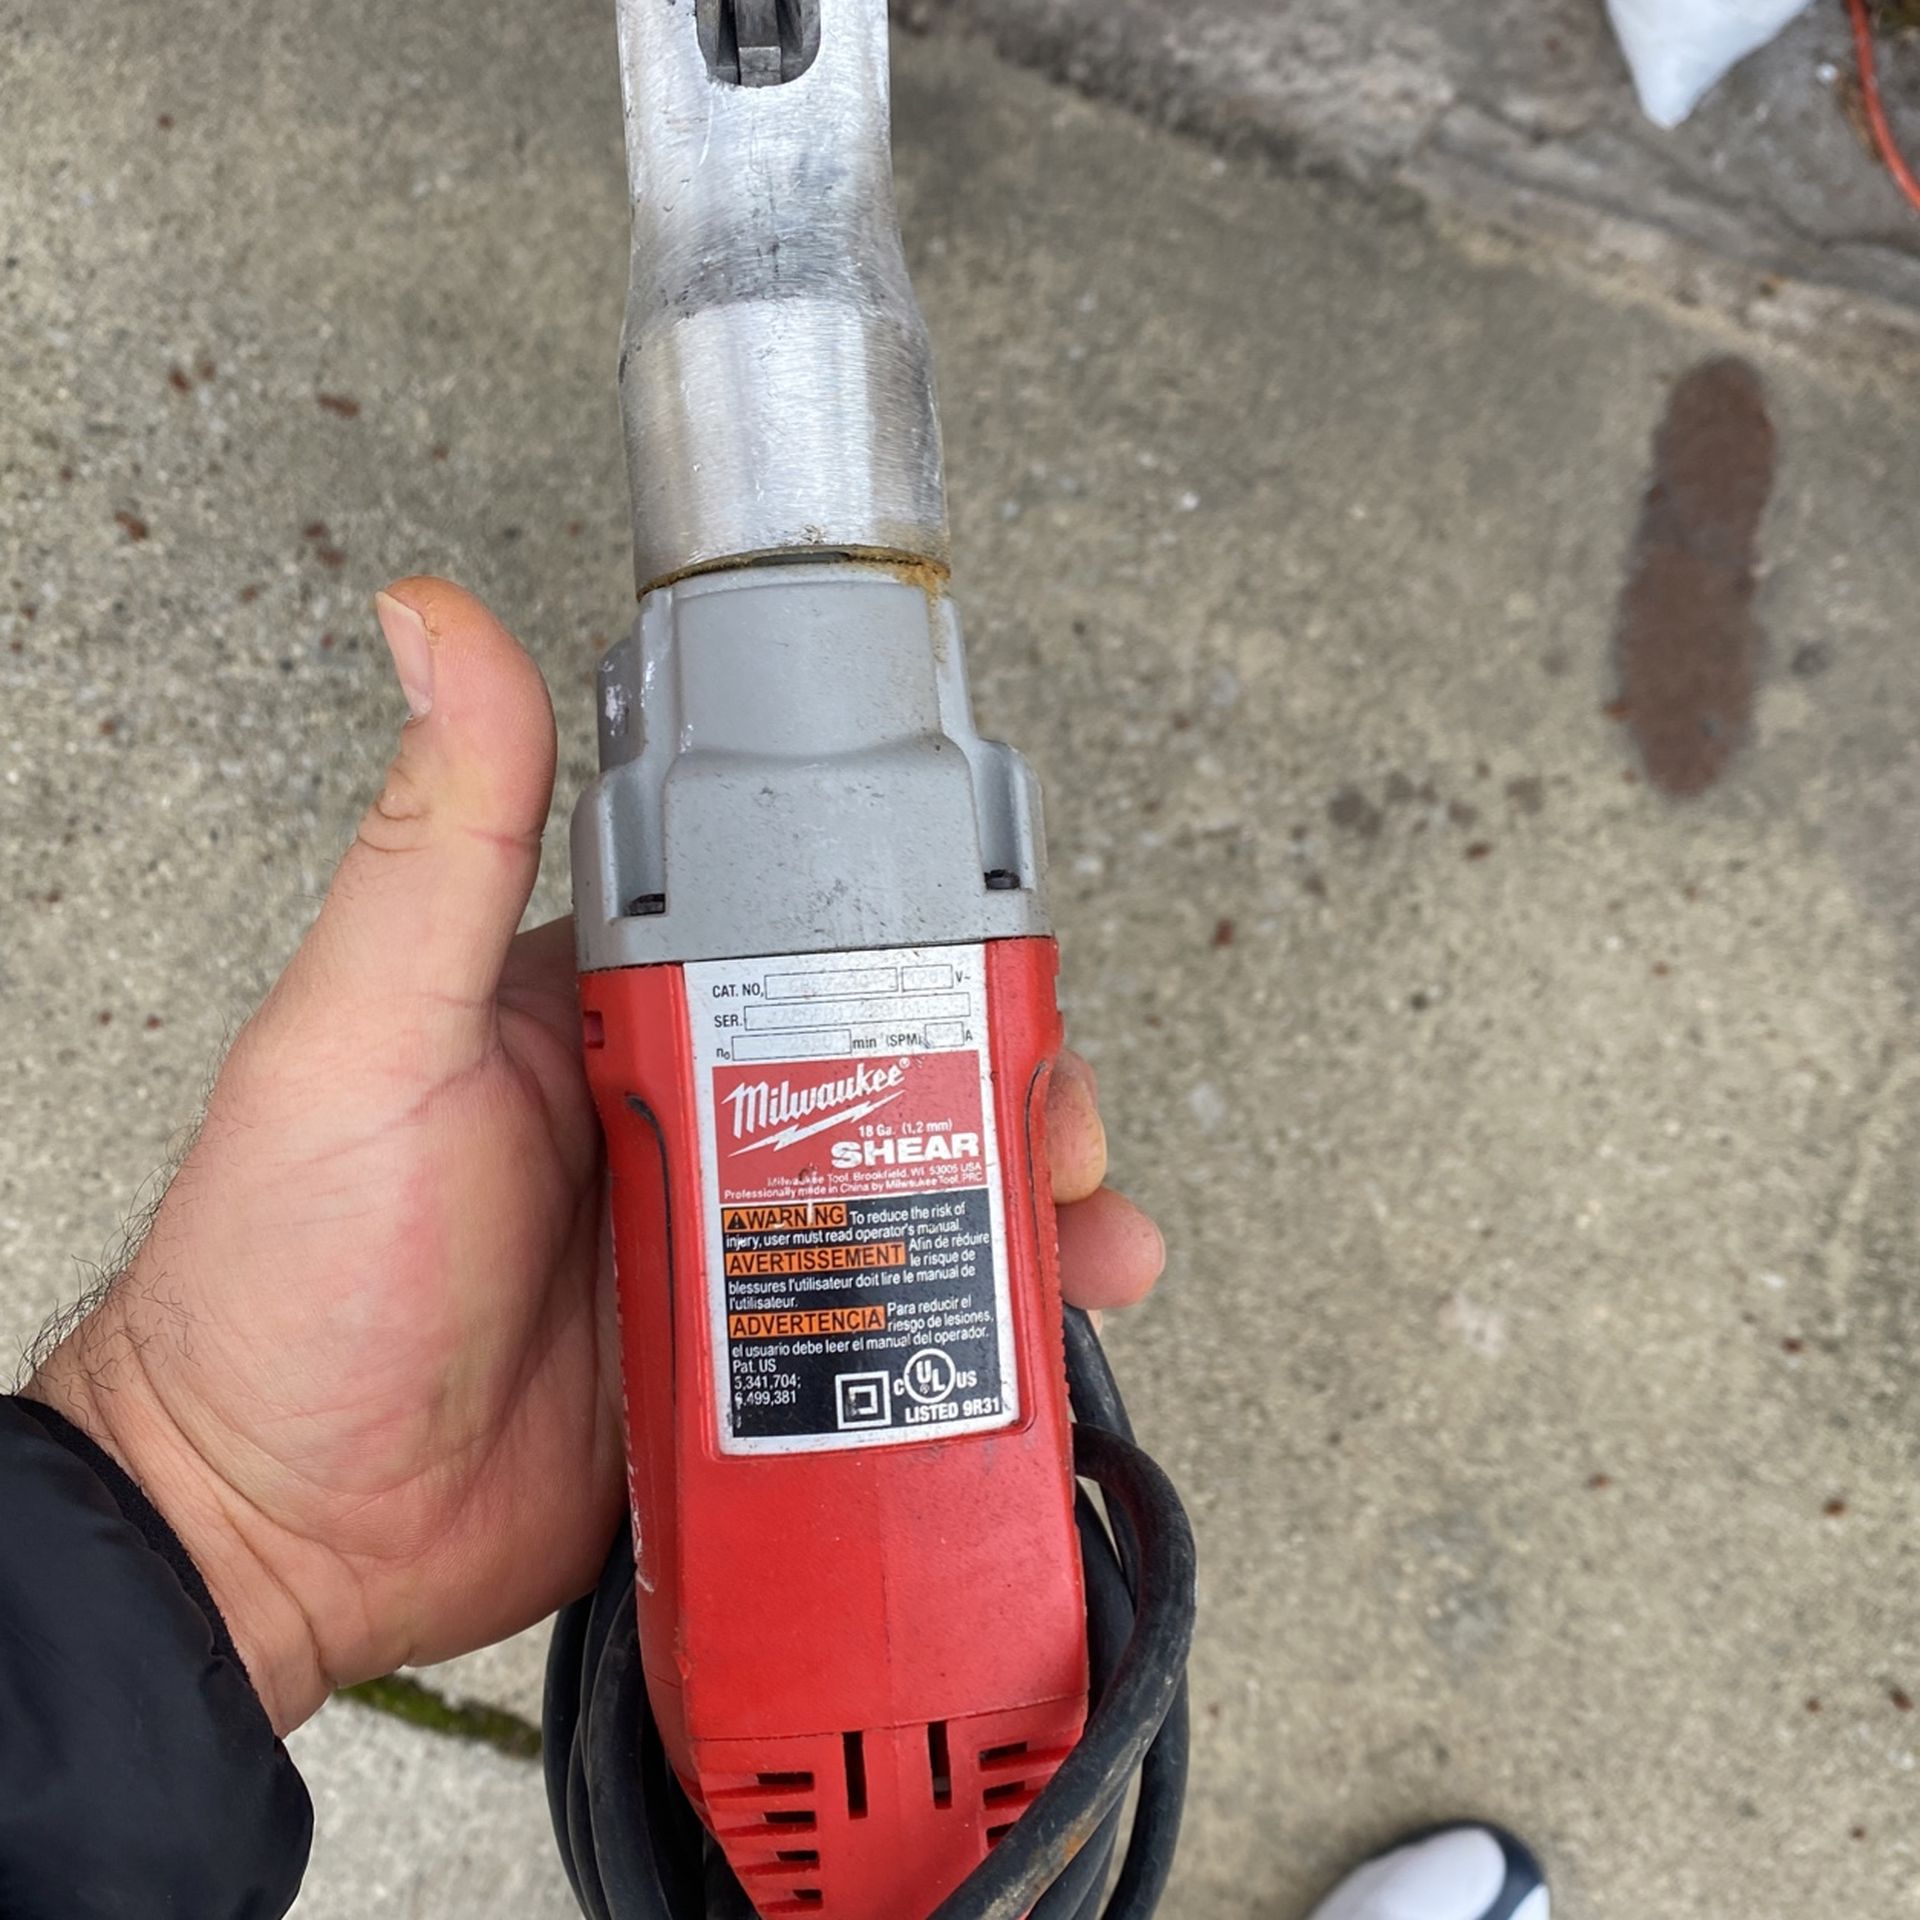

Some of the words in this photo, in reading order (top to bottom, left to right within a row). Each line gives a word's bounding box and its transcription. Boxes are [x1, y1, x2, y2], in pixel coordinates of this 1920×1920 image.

[712, 983, 739, 998] CAT.
[714, 1013, 743, 1028] SER.
[965, 1029, 973, 1041] A
[859, 1125, 874, 1137] 18
[926, 1118, 953, 1132] mm)
[831, 1132, 979, 1169] SHEAR
[961, 1161, 982, 1173] USA
[723, 1187, 796, 1200] Professionally
[798, 1184, 827, 1197] made
[828, 1182, 838, 1194] in
[839, 1180, 869, 1193] China
[870, 1180, 884, 1192] by
[961, 1171, 983, 1183] PRC
[746, 1205, 844, 1230] WARNNG
[849, 1211, 865, 1225] To
[867, 1209, 909, 1223] reduce
[911, 1206, 929, 1219] the
[931, 1203, 953, 1218] risk
[954, 1201, 966, 1215] of
[726, 1234, 762, 1251] injury,
[763, 1233, 790, 1247] user
[792, 1230, 823, 1244] must
[825, 1227, 853, 1242] read
[855, 1223, 915, 1243] operator's
[908, 1236, 933, 1251] Afin
[935, 1235, 949, 1248] de
[951, 1232, 990, 1247] réduire
[728, 1244, 903, 1274] AVERTISSEMENT
[910, 1253, 921, 1267] le
[923, 1252, 959, 1267] risque
[961, 1249, 976, 1261] de
[728, 1280, 787, 1295] blessures
[788, 1276, 853, 1292] l'utilisateur
[855, 1273, 880, 1288] doit
[881, 1272, 901, 1286] lire
[903, 1270, 914, 1284] le
[916, 1264, 959, 1282] manual
[961, 1265, 976, 1278] de
[729, 1296, 799, 1311] l'utilisateur.
[887, 1302, 916, 1317] Para
[918, 1296, 959, 1314] reducir
[961, 1294, 972, 1308] el
[732, 1309, 882, 1337] ADVERTENCIA
[887, 1317, 926, 1334] riesgo
[927, 1315, 942, 1328] de
[732, 1344, 743, 1358] el
[745, 1342, 790, 1358] usuario
[791, 1340, 823, 1356] debe
[825, 1339, 850, 1354] leer
[852, 1336, 864, 1351] el
[866, 1334, 911, 1350] manual
[913, 1330, 932, 1345] del
[934, 1325, 989, 1346] operador.
[758, 1358, 777, 1373] US
[916, 1359, 946, 1393] UL
[956, 1370, 978, 1389] US
[904, 1401, 959, 1424] LISTED
[962, 1395, 1000, 1417] 9R31
